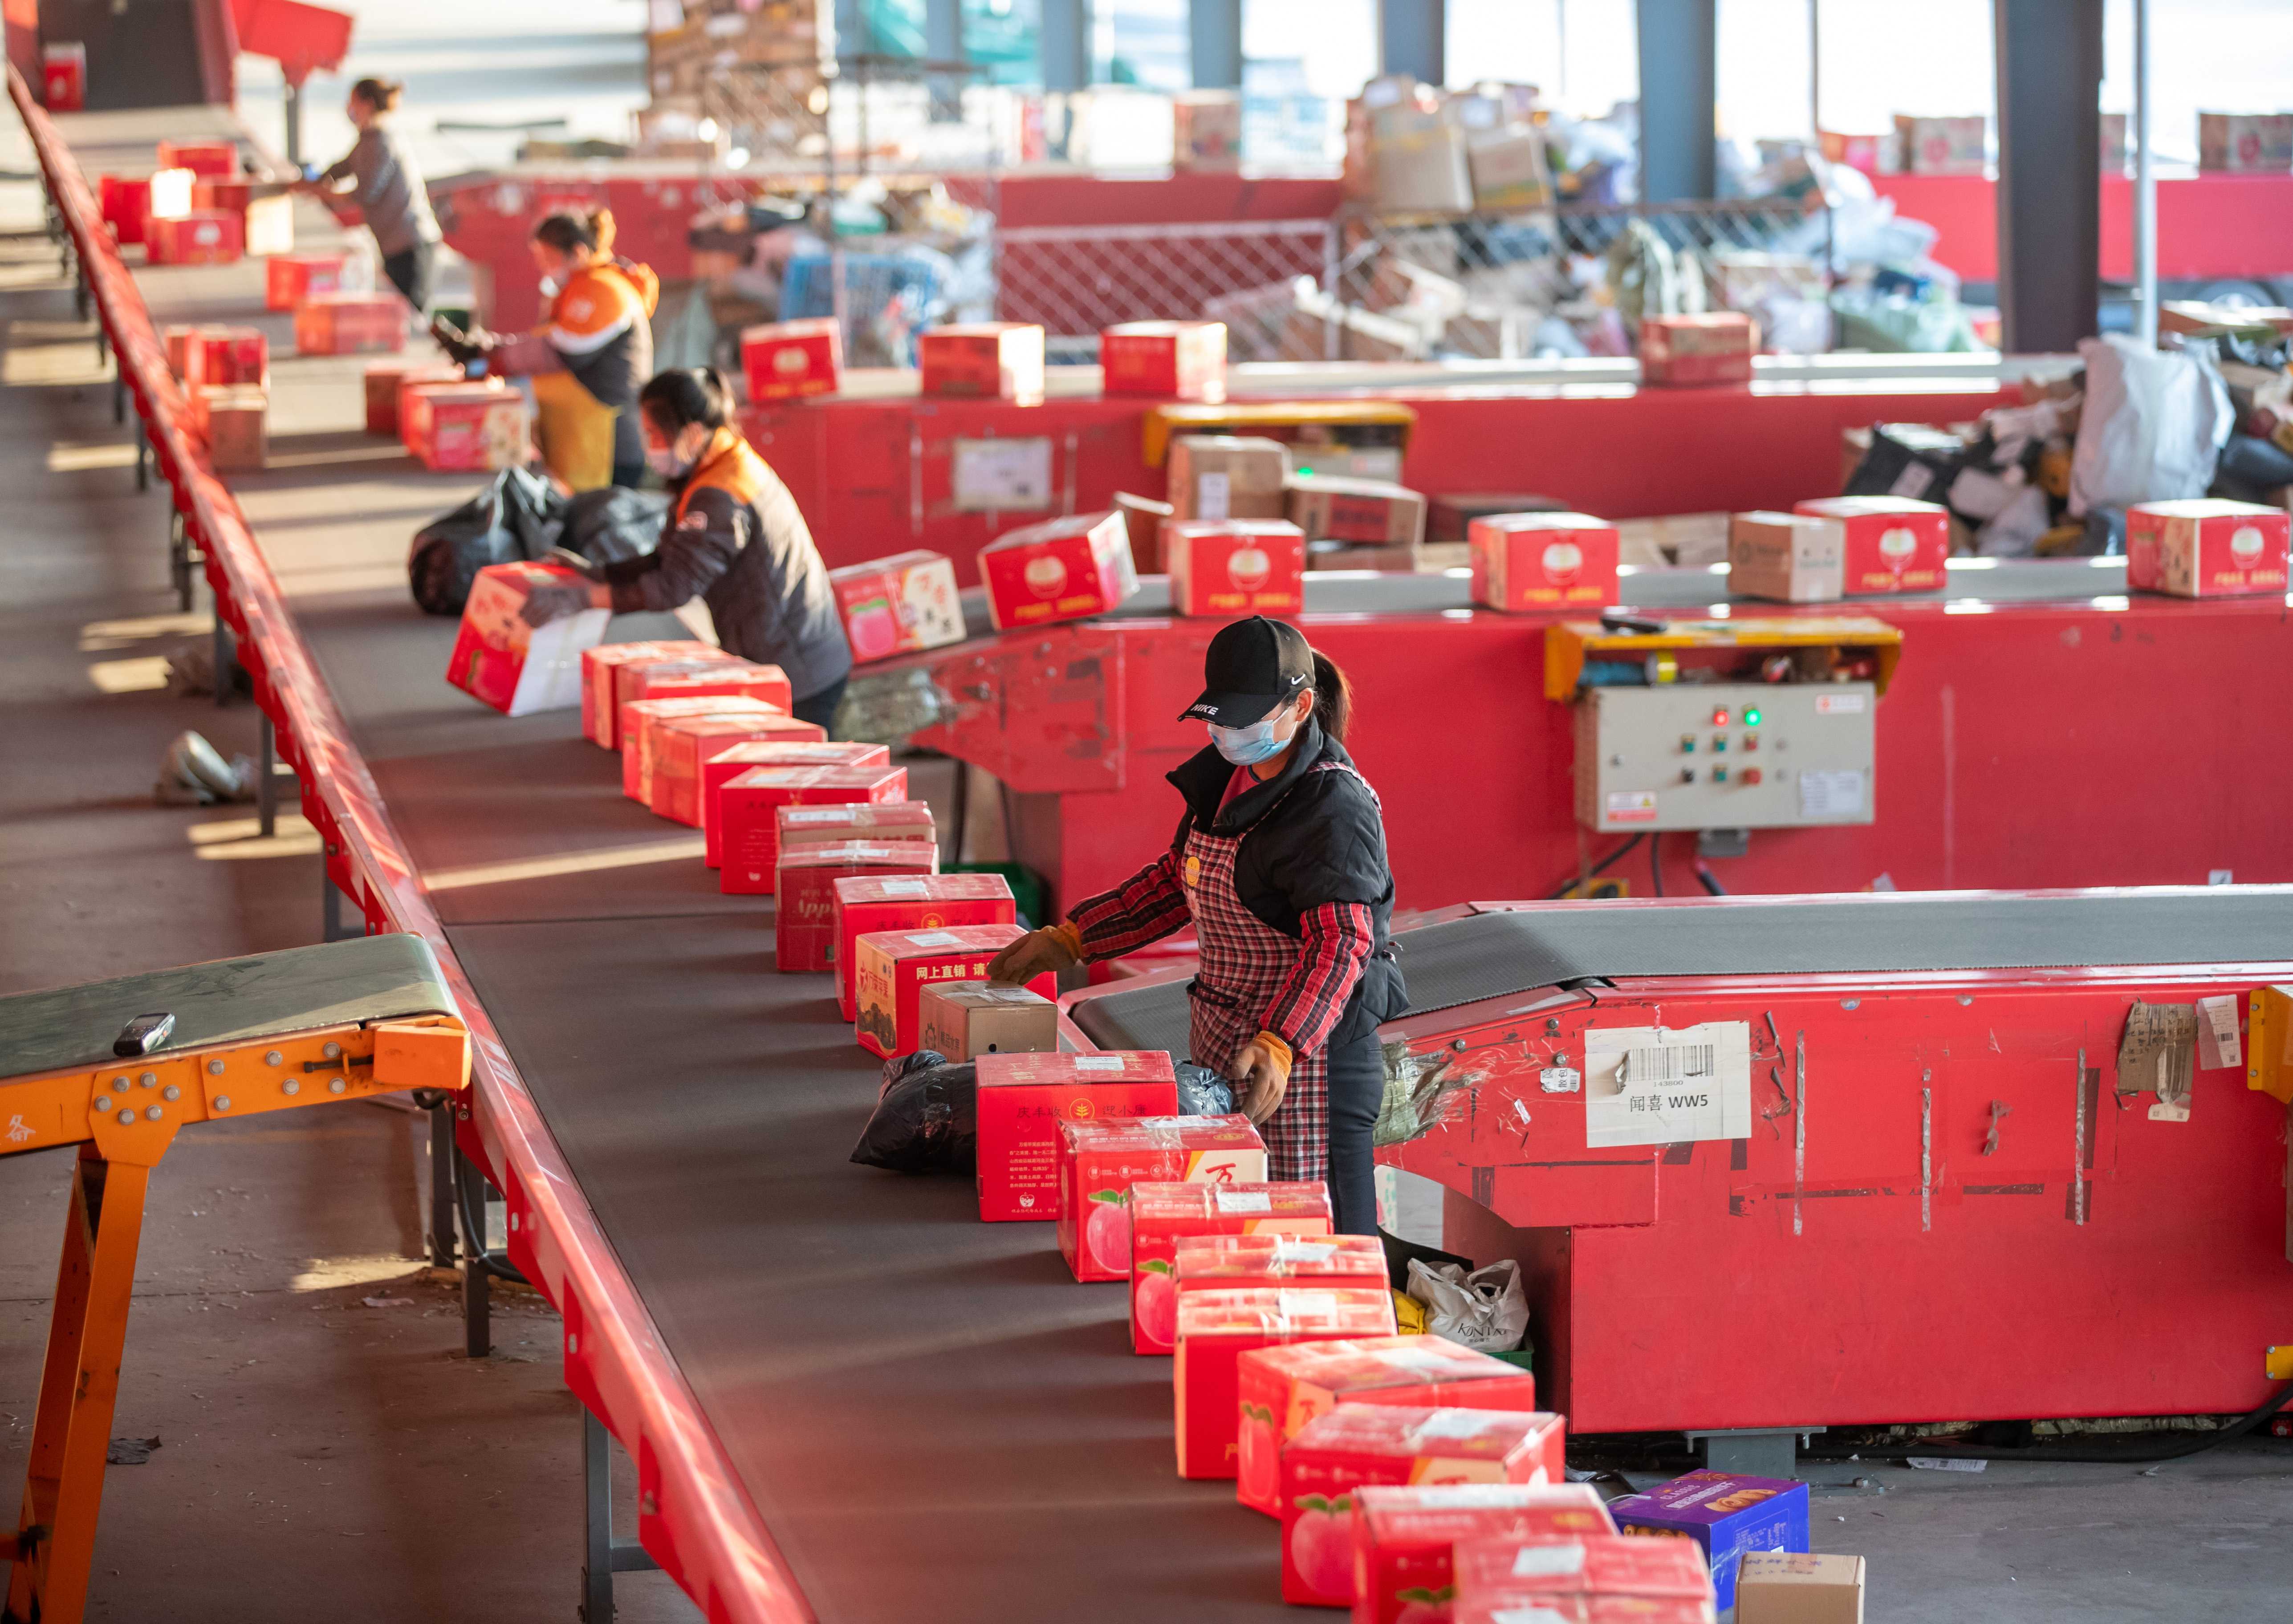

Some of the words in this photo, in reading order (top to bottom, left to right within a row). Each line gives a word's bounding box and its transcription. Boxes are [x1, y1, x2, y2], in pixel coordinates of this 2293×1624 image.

[1190, 704, 1219, 715] NIKE
[916, 964, 966, 980] 网上直销
[973, 962, 990, 976] 请
[1016, 1106, 1062, 1118] 庆丰收
[1101, 1105, 1147, 1116] 迎小康
[1630, 1095, 1662, 1112] 闻喜
[1668, 1095, 1708, 1108] WW5
[1205, 1163, 1236, 1182] 万
